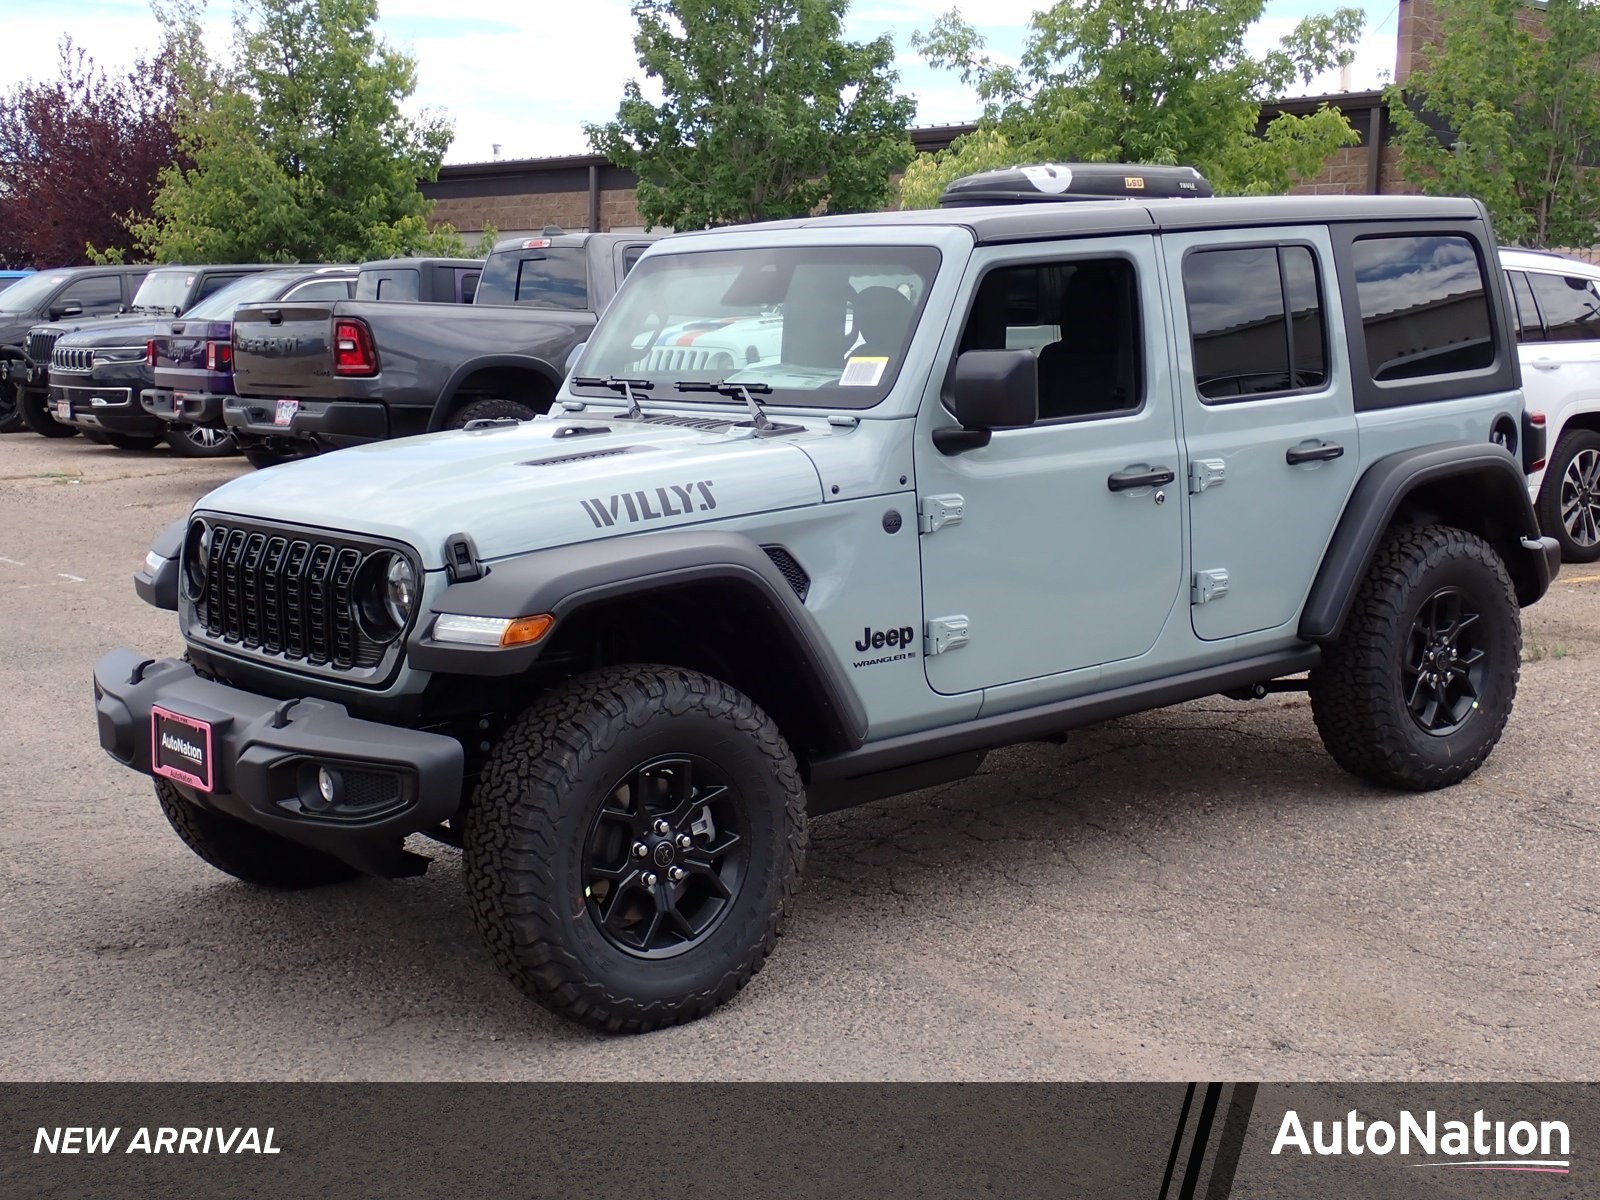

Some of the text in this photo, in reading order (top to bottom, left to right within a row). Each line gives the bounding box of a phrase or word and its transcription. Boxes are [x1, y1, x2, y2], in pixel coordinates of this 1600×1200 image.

[1126, 179, 1143, 187] LSU
[580, 480, 717, 528] WILLYS
[855, 626, 914, 652] Jeep
[853, 653, 906, 668] WRANGLER
[162, 732, 202, 760] AutoNation
